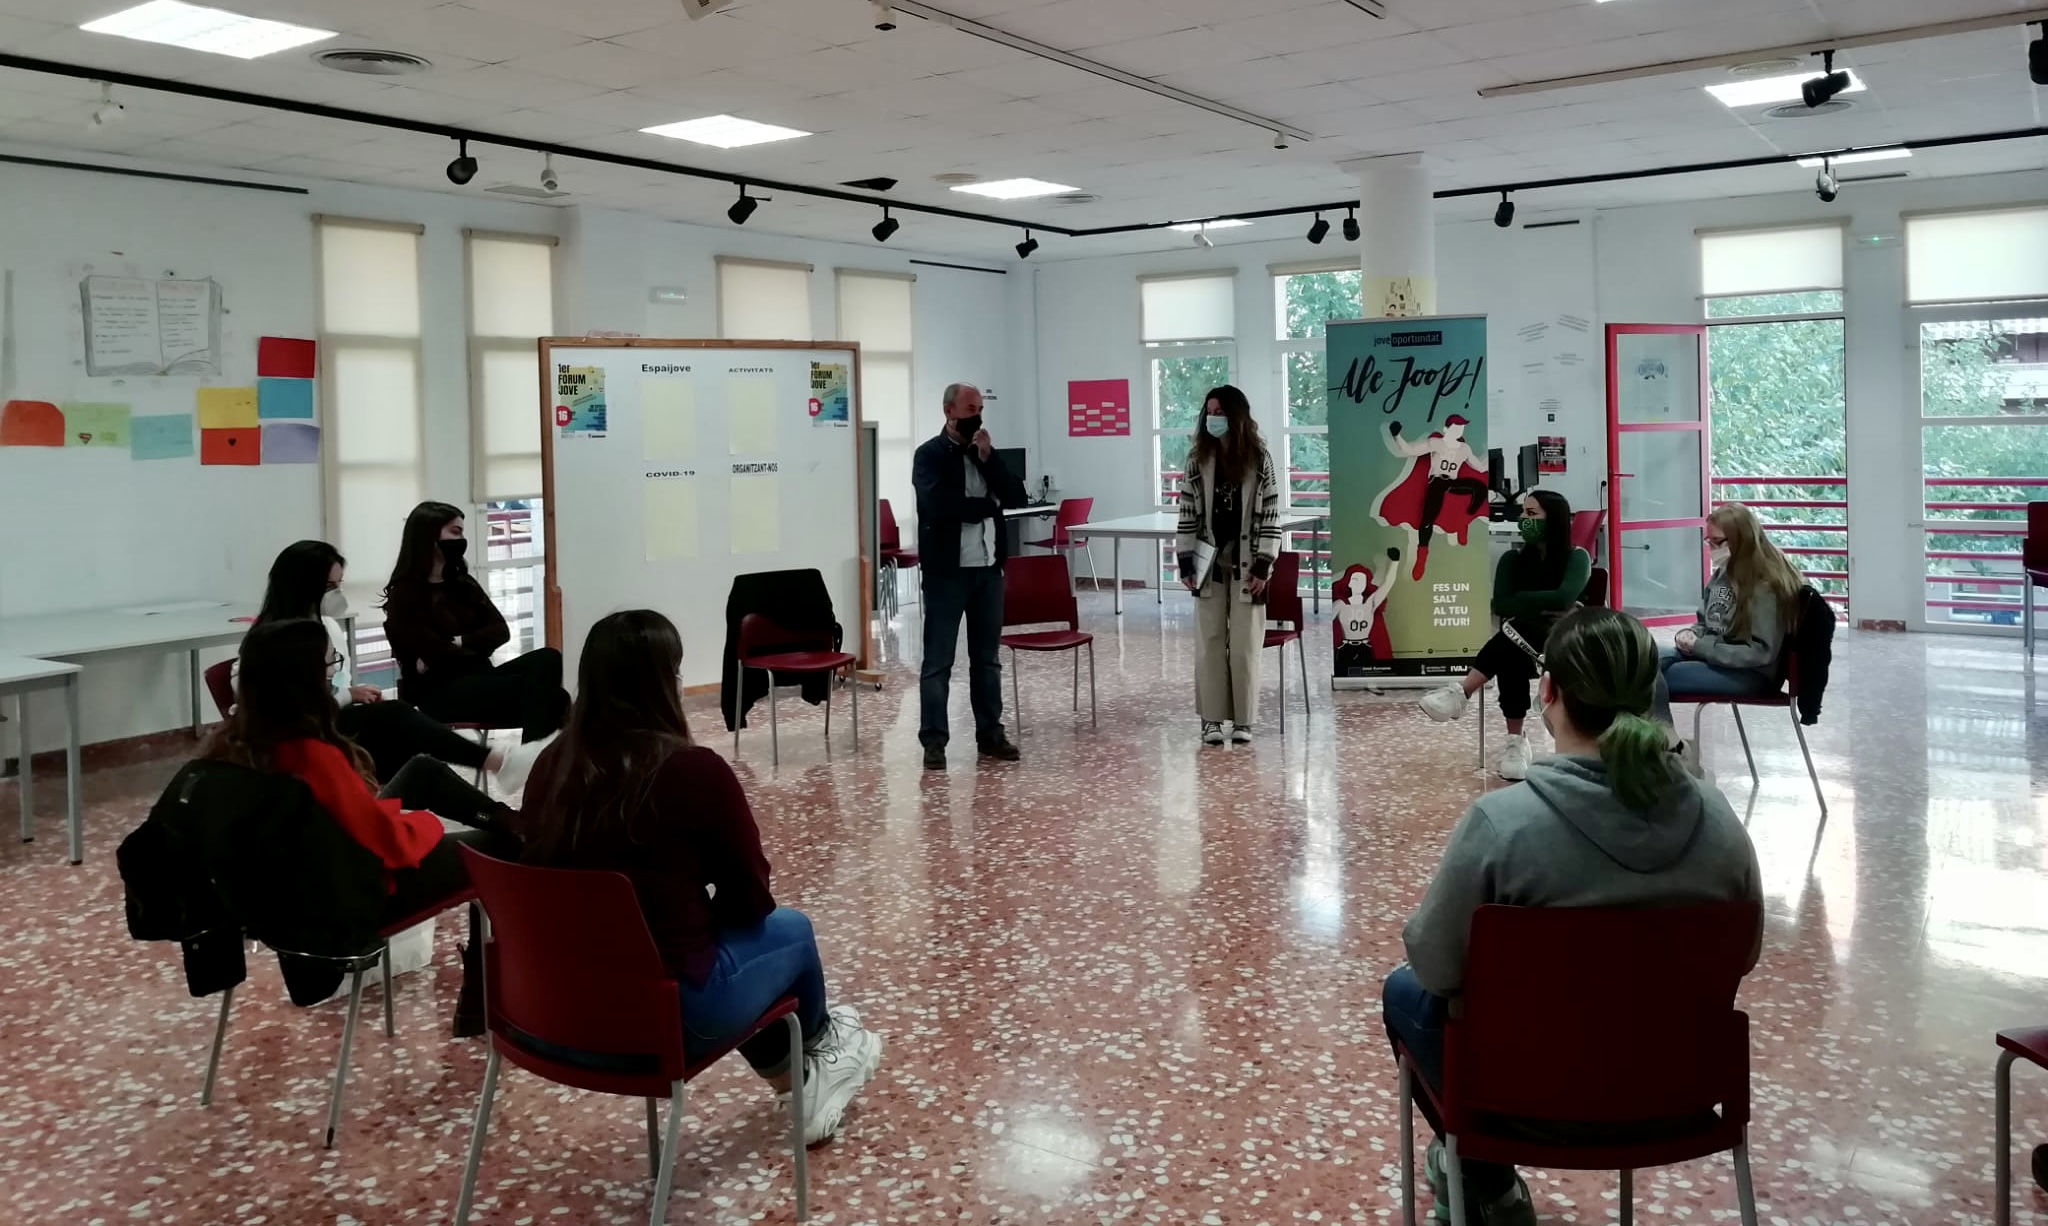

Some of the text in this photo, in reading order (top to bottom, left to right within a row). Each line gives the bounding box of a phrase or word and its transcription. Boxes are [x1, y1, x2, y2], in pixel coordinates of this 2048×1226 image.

[1392, 332, 1440, 346] oportunitat
[558, 364, 570, 373] 1er
[642, 364, 691, 374] Espaijove
[558, 374, 586, 384] FORUM
[811, 370, 832, 379] FORUM
[811, 380, 826, 389] JOVE
[558, 385, 578, 395] JOVE
[558, 410, 568, 421] 16
[1433, 583, 1470, 592] FES UN
[1433, 595, 1457, 603] SALT
[1433, 606, 1468, 615] AL TEU
[1450, 665, 1468, 673] IVAJ
